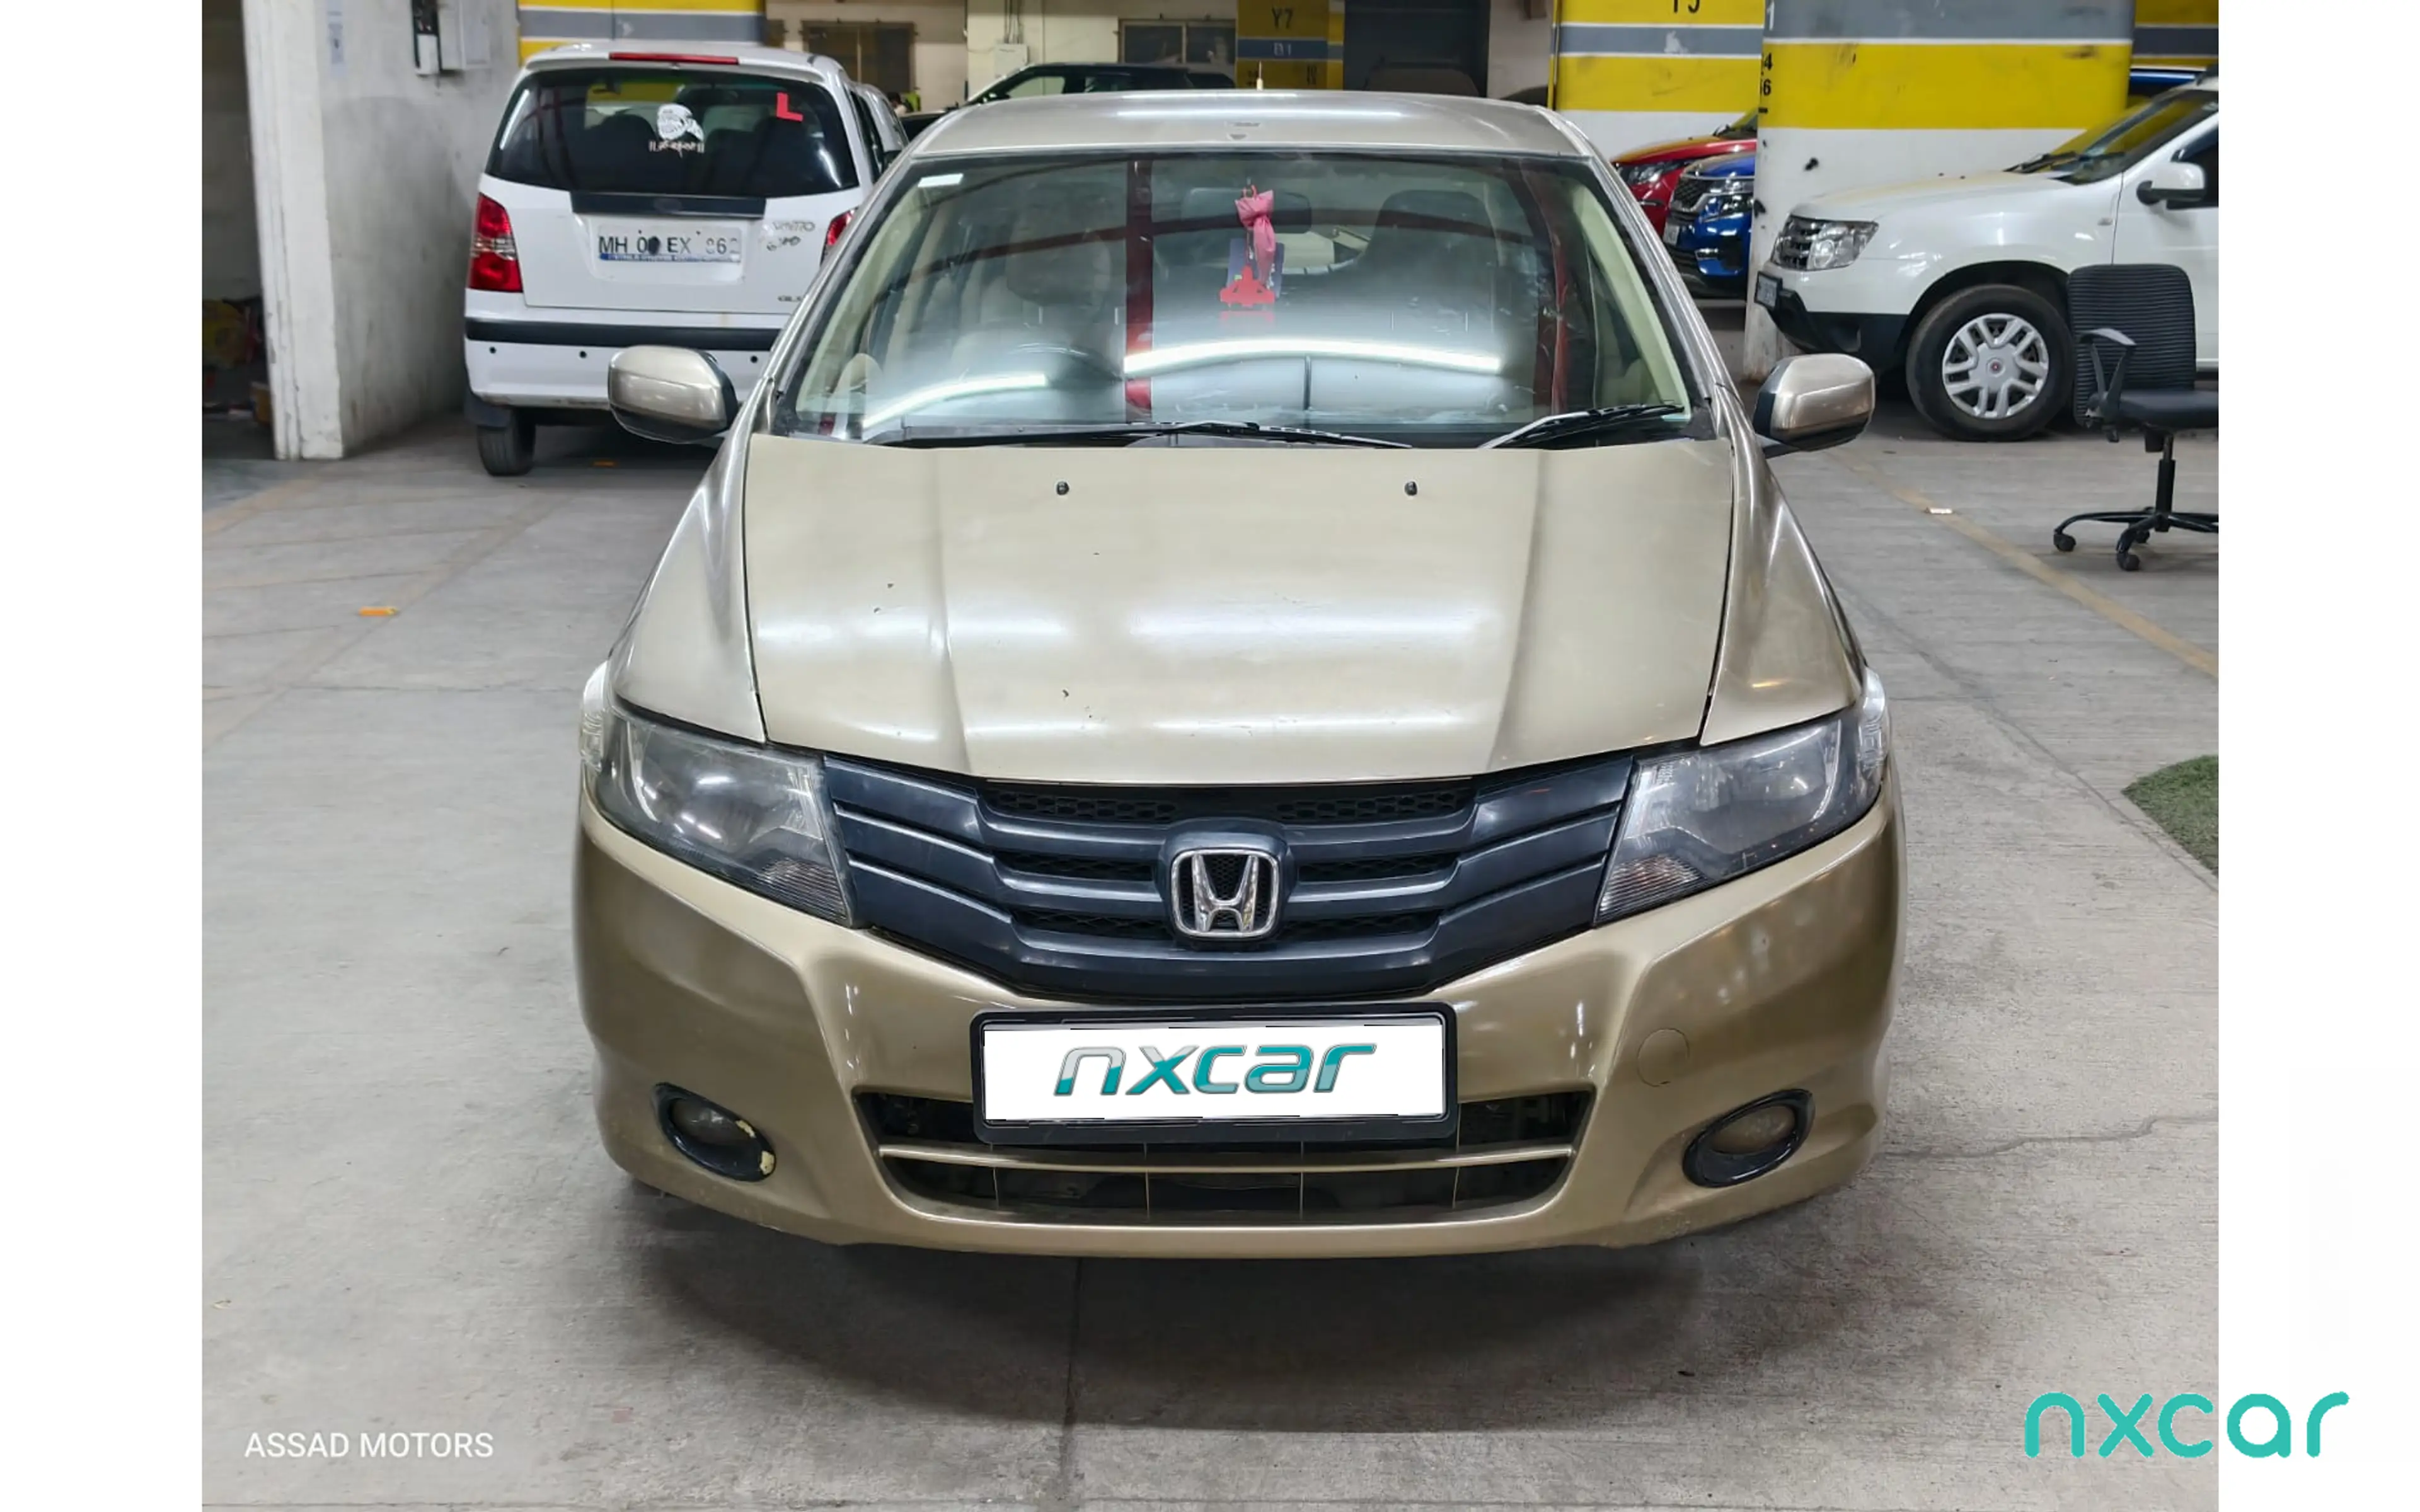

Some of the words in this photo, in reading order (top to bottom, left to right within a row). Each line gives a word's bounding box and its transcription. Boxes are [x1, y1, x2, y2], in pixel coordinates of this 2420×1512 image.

[1272, 7, 1294, 29] Y7
[776, 92, 804, 122] L
[599, 236, 628, 253] MH
[667, 237, 691, 253] EX
